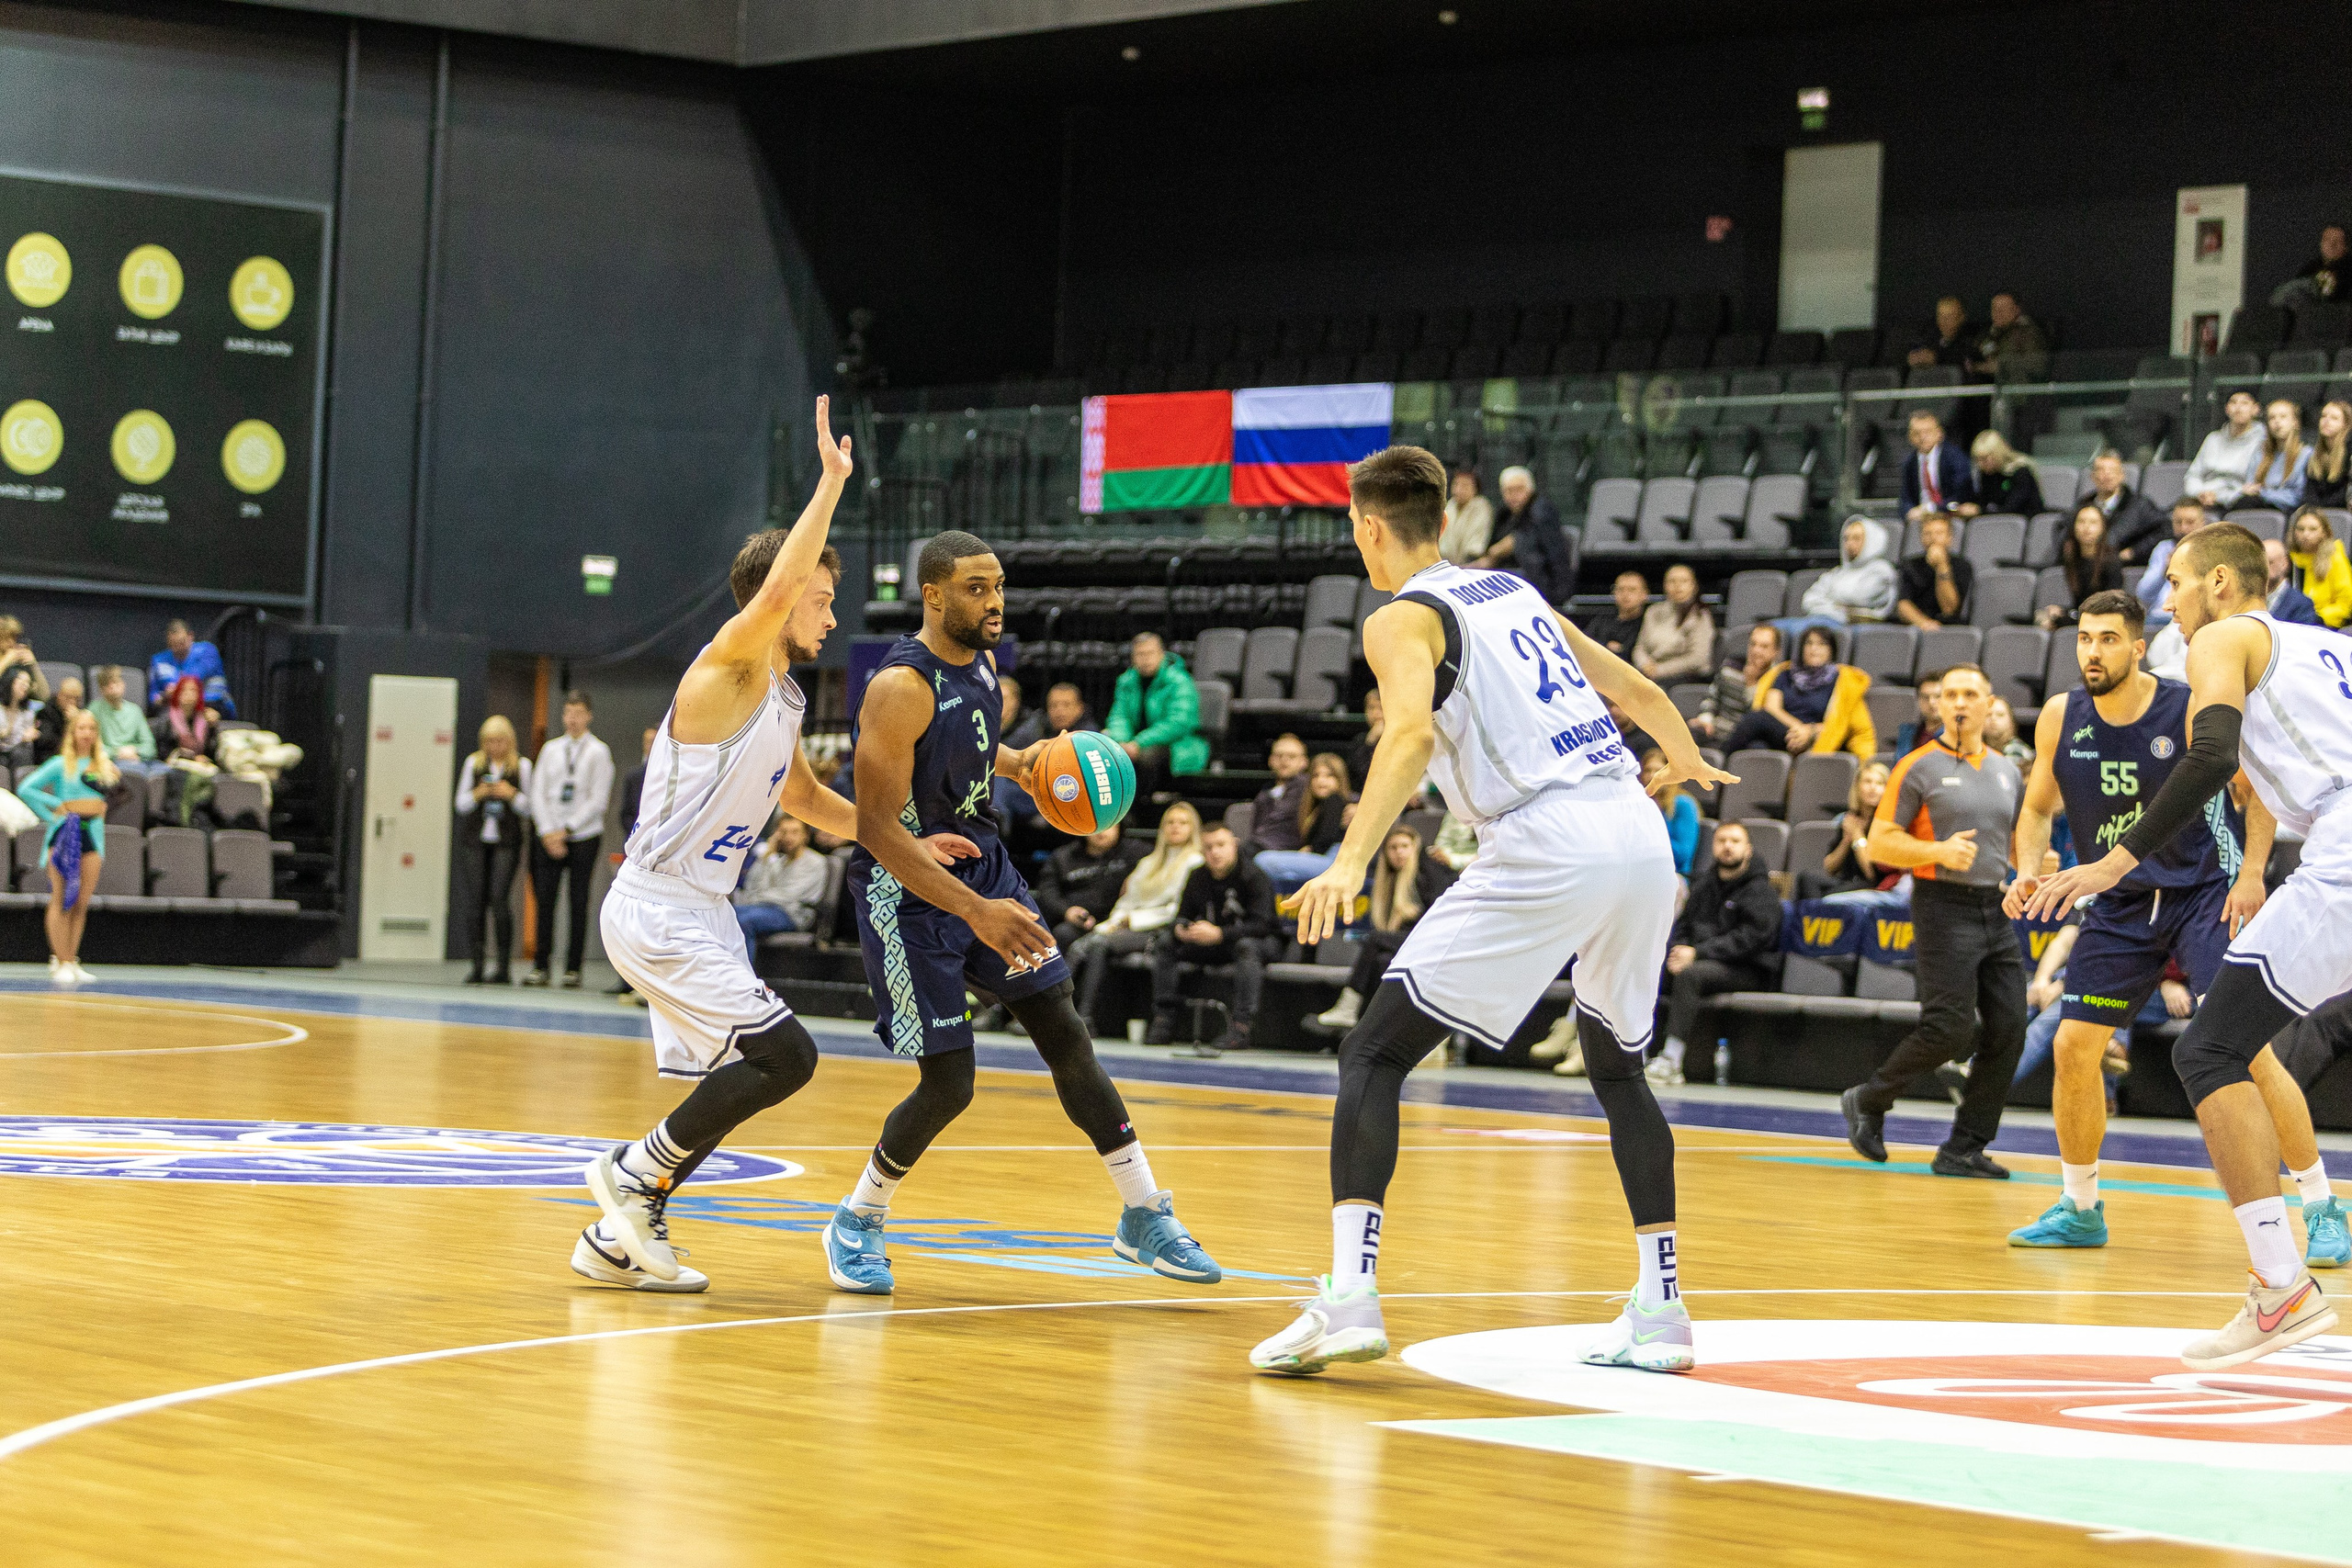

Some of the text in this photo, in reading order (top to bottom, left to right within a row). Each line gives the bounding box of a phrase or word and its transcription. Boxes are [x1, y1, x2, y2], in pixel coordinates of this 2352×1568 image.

[1447, 573, 1523, 605] DOLININ
[1510, 615, 1587, 704] 23
[938, 695, 963, 712] Kempa
[971, 708, 989, 752] 3
[2069, 749, 2099, 761] Kempa
[1085, 750, 1113, 806] SIBUR
[2100, 761, 2140, 796] 55
[1802, 915, 1844, 947] VIP
[933, 1014, 963, 1028] Kempa
